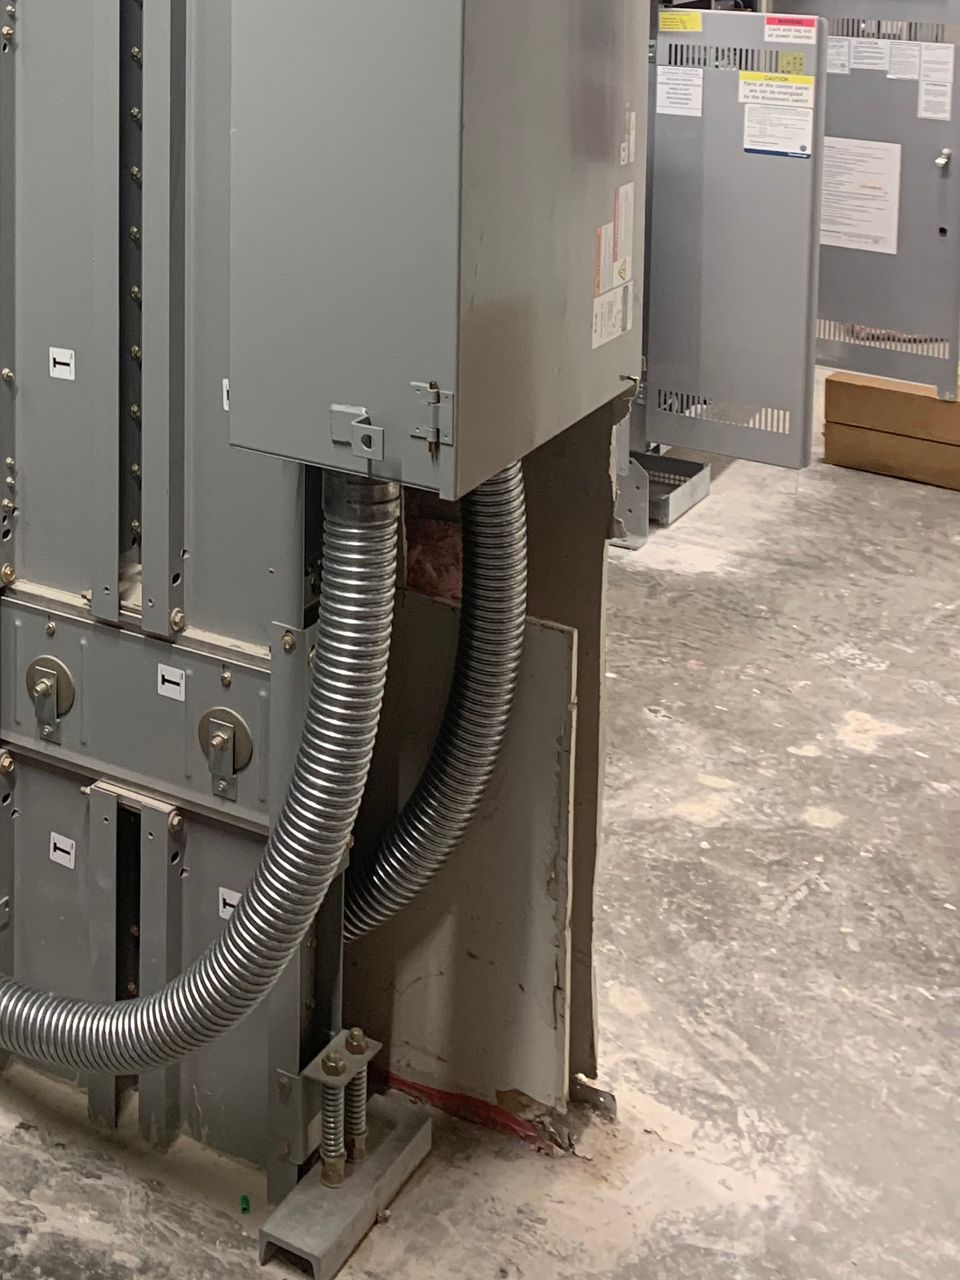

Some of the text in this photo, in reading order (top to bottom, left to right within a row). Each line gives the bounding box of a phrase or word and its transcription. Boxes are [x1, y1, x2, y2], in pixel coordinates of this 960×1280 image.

[52, 357, 70, 368] T
[161, 674, 180, 687] T
[53, 842, 71, 856] T
